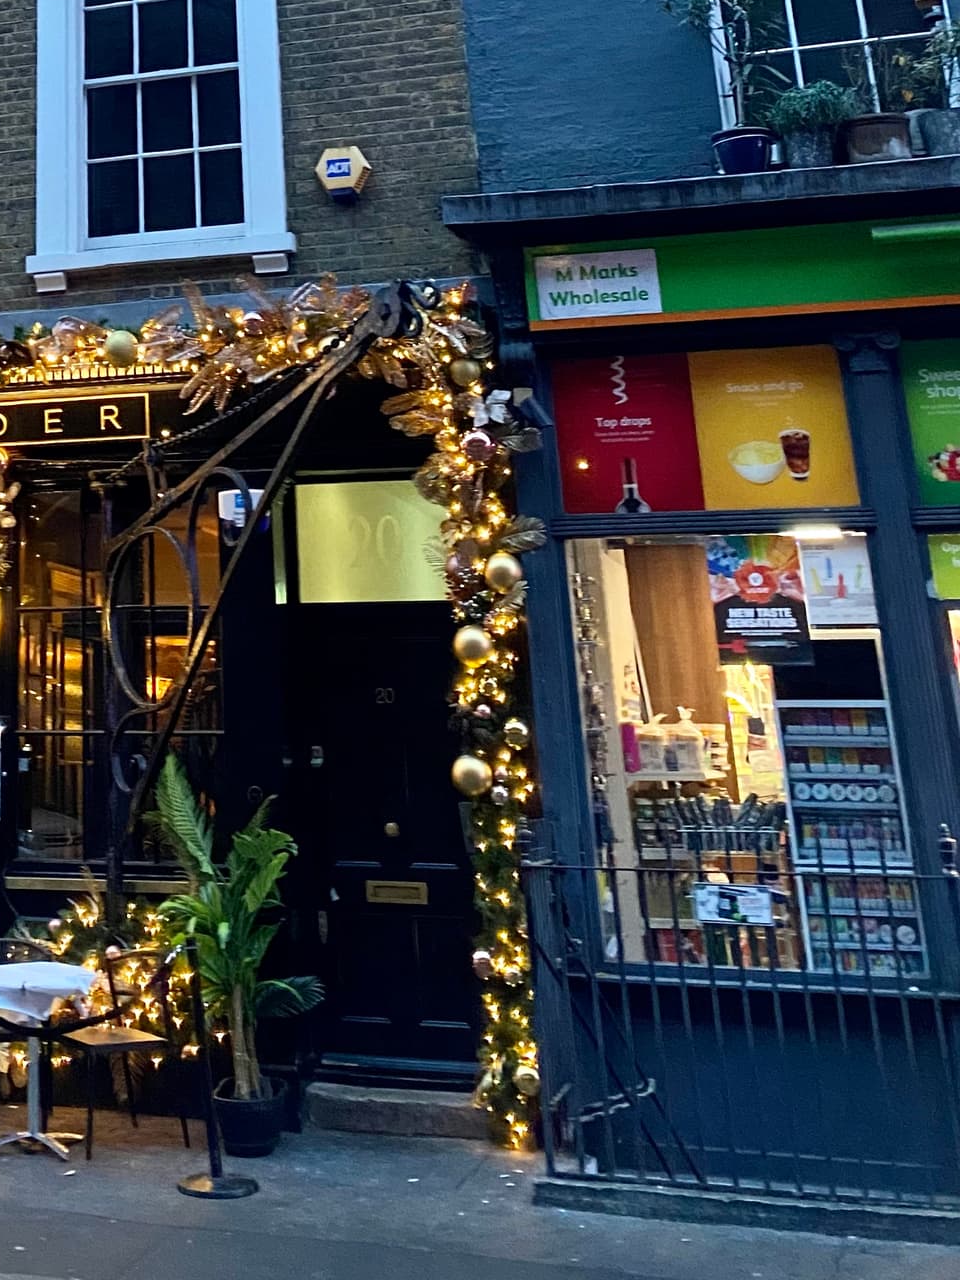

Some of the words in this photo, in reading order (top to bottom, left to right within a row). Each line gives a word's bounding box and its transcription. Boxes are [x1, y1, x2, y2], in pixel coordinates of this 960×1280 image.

[327, 161, 351, 174] ADT
[554, 267, 573, 282] M
[580, 263, 638, 281] Marks
[549, 286, 649, 307] Wholesale
[756, 607, 792, 618] TASTE
[375, 687, 396, 704] 20
